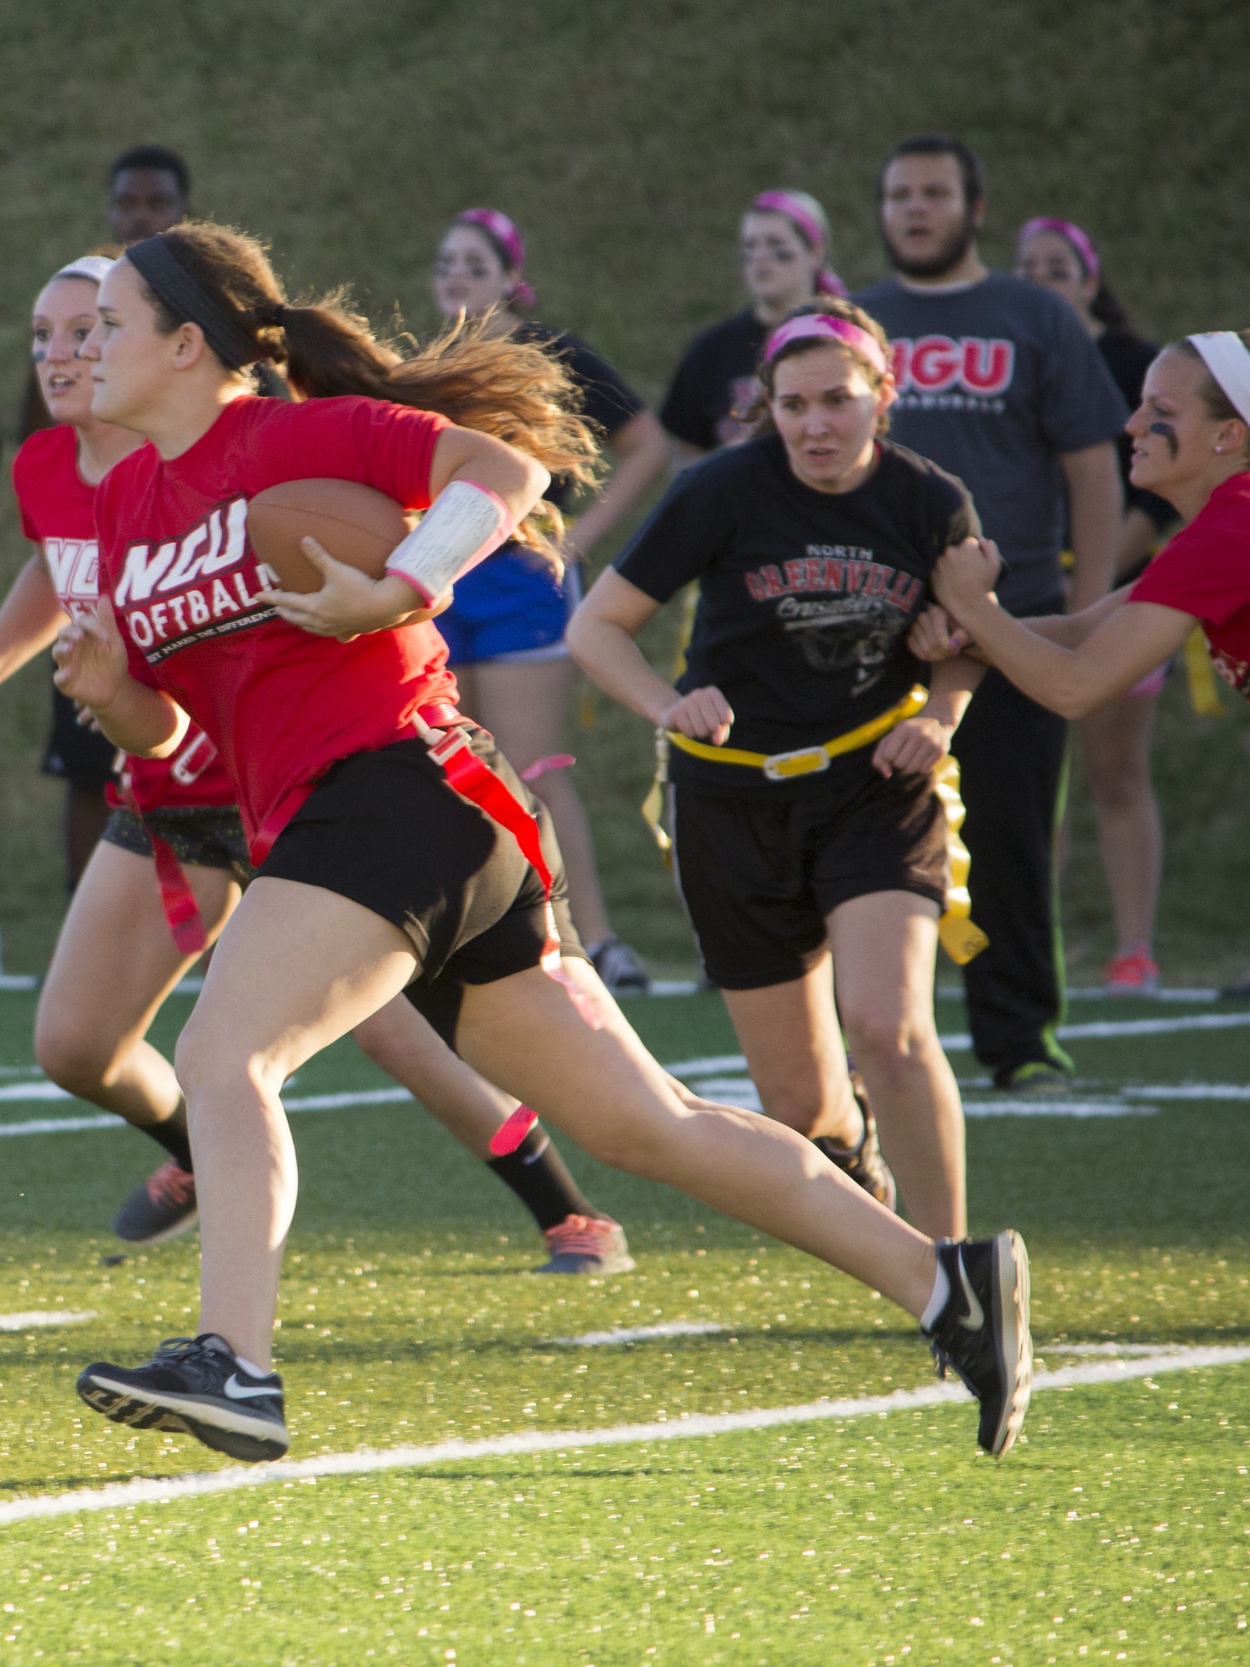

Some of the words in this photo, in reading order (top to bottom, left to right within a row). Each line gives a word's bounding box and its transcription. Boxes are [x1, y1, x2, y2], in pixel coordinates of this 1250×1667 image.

[46, 537, 99, 600] NC
[114, 496, 249, 609] NCU
[806, 543, 873, 560] NORTH
[127, 562, 283, 648] OFTBALL
[196, 627, 217, 640] THE
[216, 607, 278, 634] DIFFERENC
